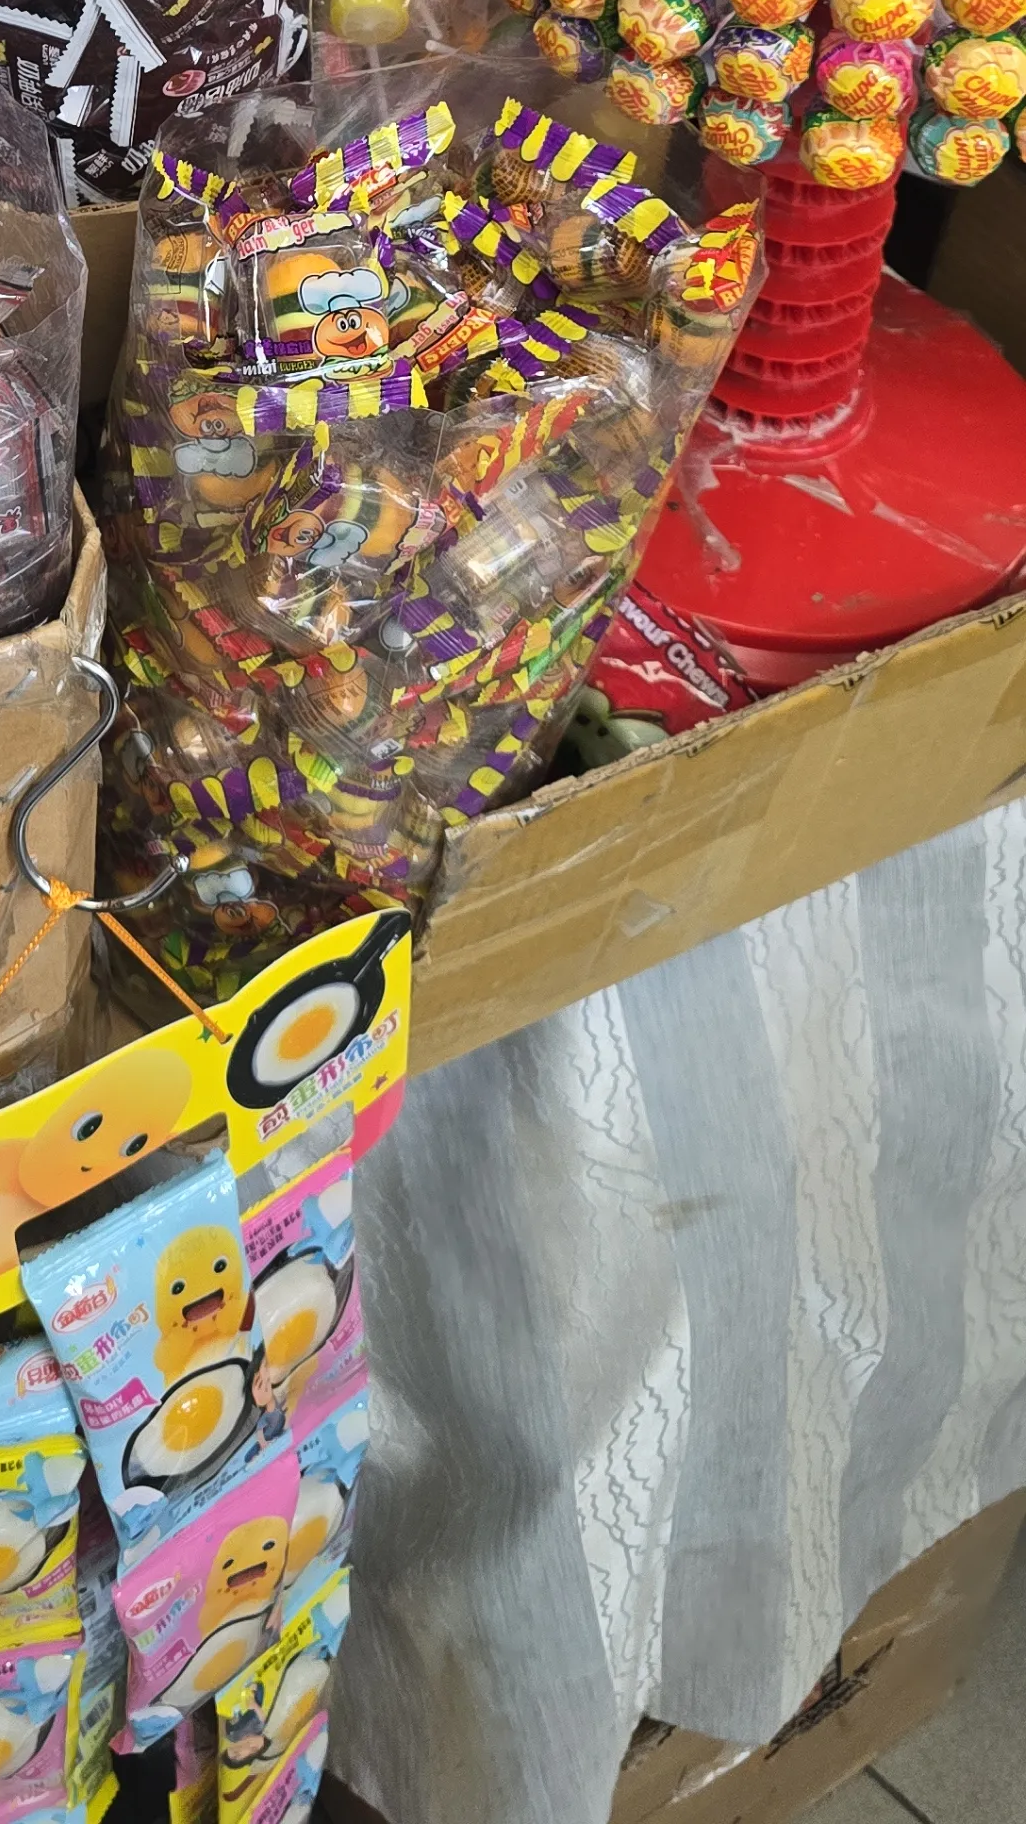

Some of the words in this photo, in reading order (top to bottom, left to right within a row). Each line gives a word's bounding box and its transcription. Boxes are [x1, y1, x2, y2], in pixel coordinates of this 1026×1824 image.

[852, 1, 909, 36] Chupa
[832, 74, 882, 109] Chupa
[963, 75, 1020, 109] Chupa
[423, 304, 499, 366] URGERS
[278, 360, 318, 374] BURGER
[618, 595, 672, 648] avour
